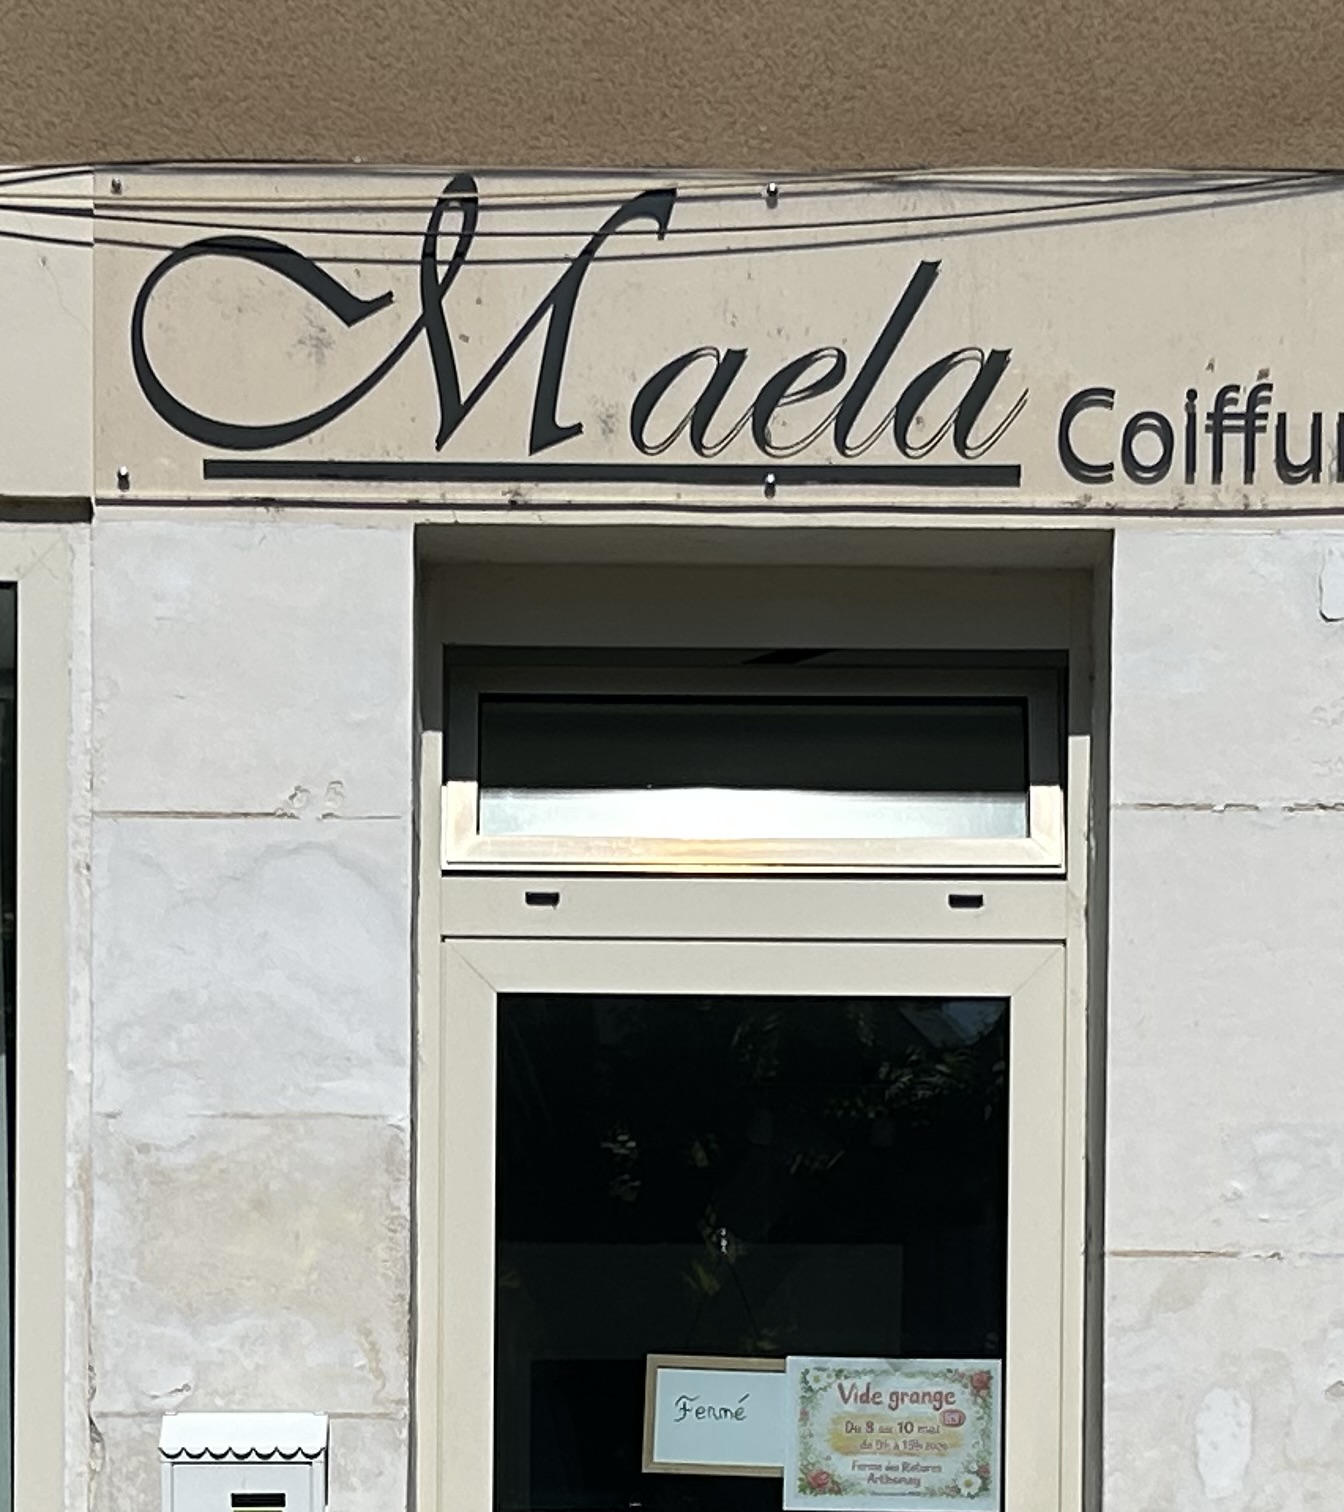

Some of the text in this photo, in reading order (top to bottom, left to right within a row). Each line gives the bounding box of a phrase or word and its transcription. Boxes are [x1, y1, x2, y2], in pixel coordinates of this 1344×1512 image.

[130, 173, 1029, 459] Maela
[673, 1393, 750, 1423] Fermé
[837, 1382, 957, 1411] Vide grange
[896, 1421, 915, 1434] 10
